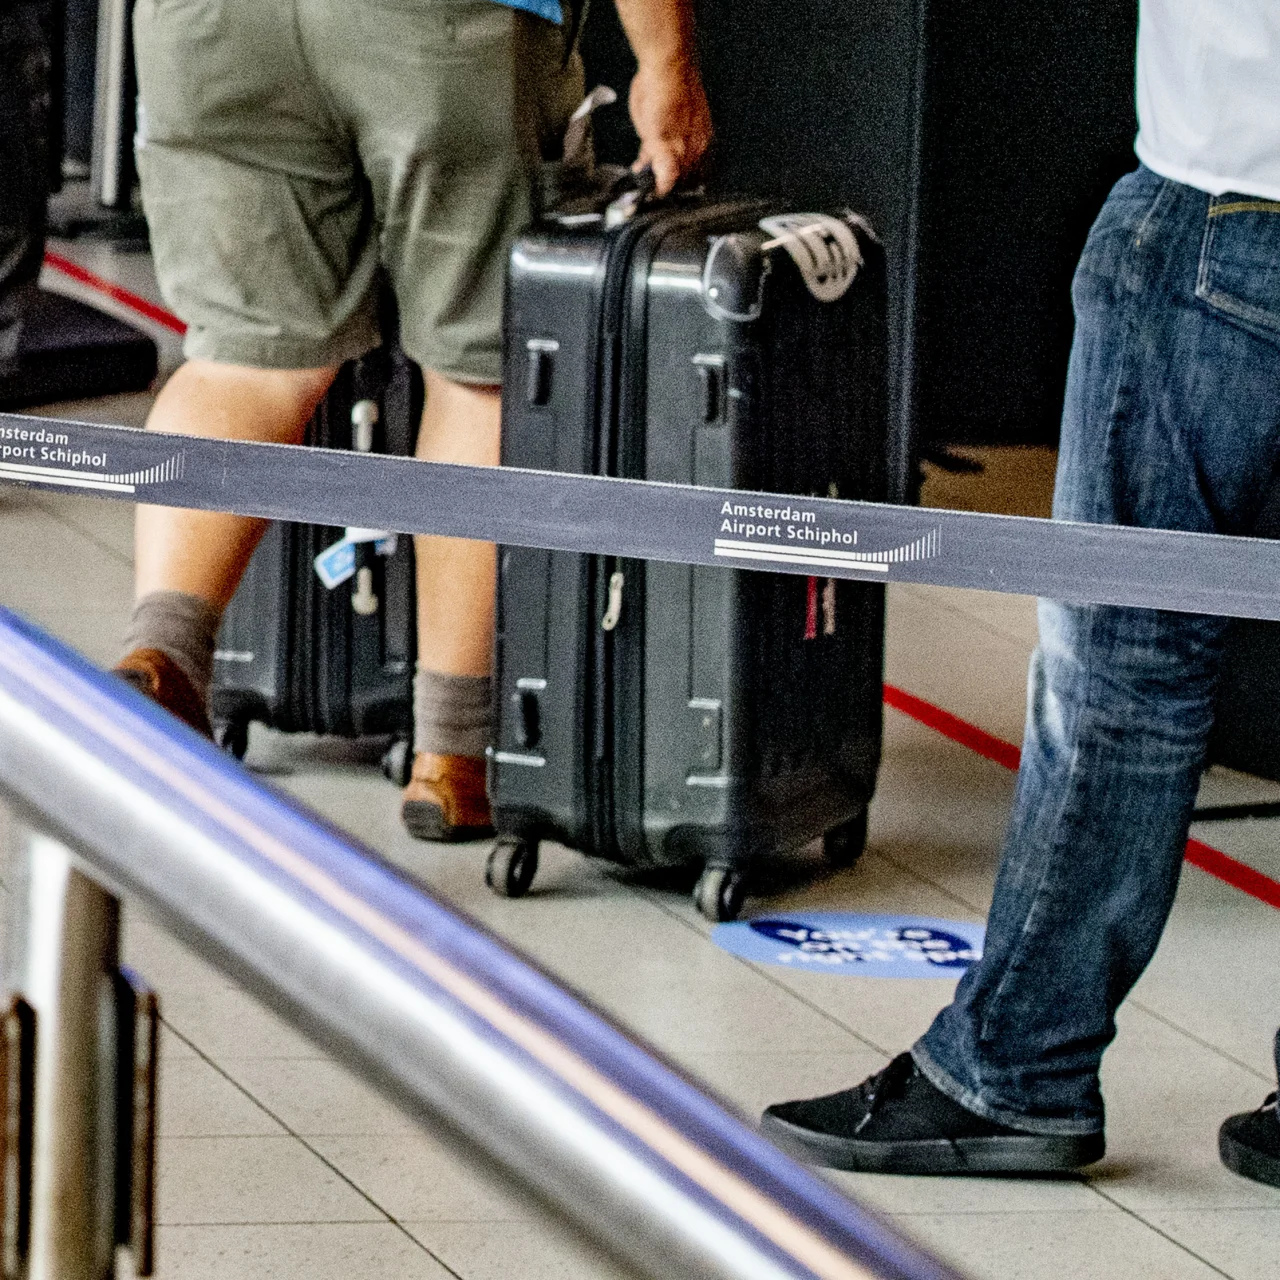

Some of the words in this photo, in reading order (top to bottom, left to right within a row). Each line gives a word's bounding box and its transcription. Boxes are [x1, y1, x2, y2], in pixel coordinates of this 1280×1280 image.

[40, 447, 107, 467] Schiphol
[720, 501, 816, 523] Amsterdam
[720, 518, 781, 538] Airport
[786, 526, 858, 545] Schiphol
